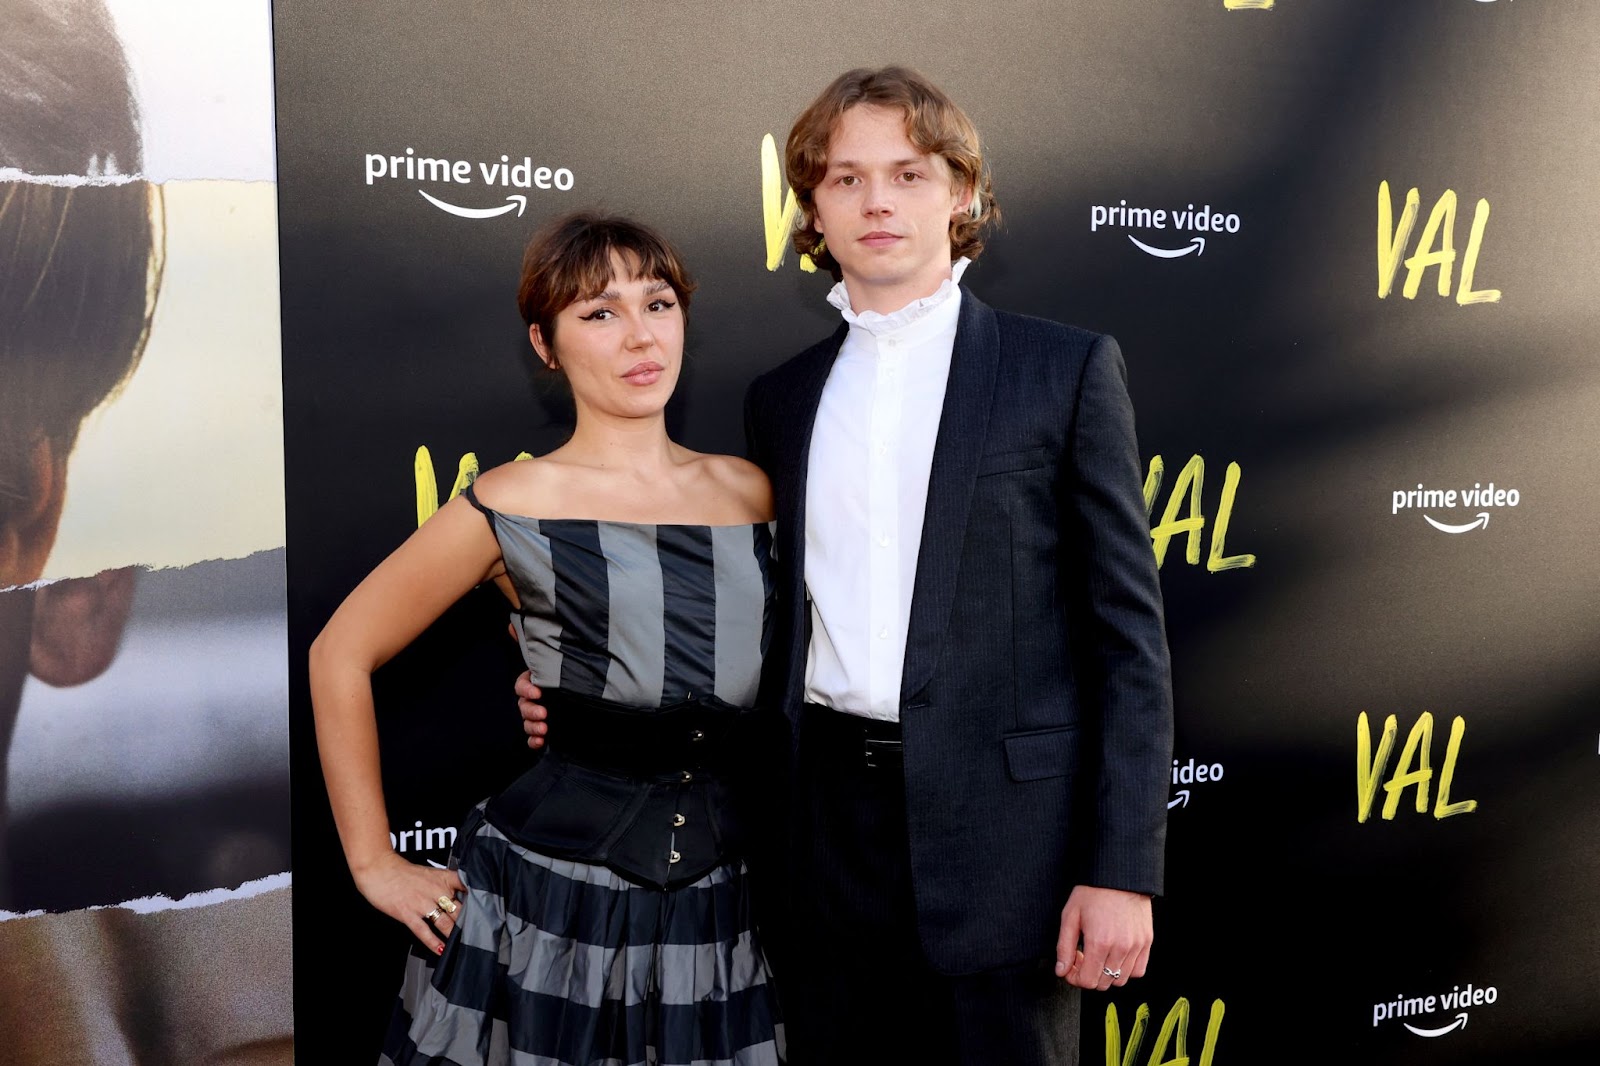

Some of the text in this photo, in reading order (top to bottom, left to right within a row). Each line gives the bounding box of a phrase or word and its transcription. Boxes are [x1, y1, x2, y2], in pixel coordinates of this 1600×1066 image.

[365, 147, 575, 191] prime video
[1091, 199, 1241, 233] prime video
[1377, 179, 1502, 306] VAL
[1392, 483, 1520, 514] prime video
[1170, 758, 1224, 785] ideo
[1357, 711, 1478, 824] VAL
[390, 820, 458, 853] rim
[1373, 984, 1498, 1026] prime video
